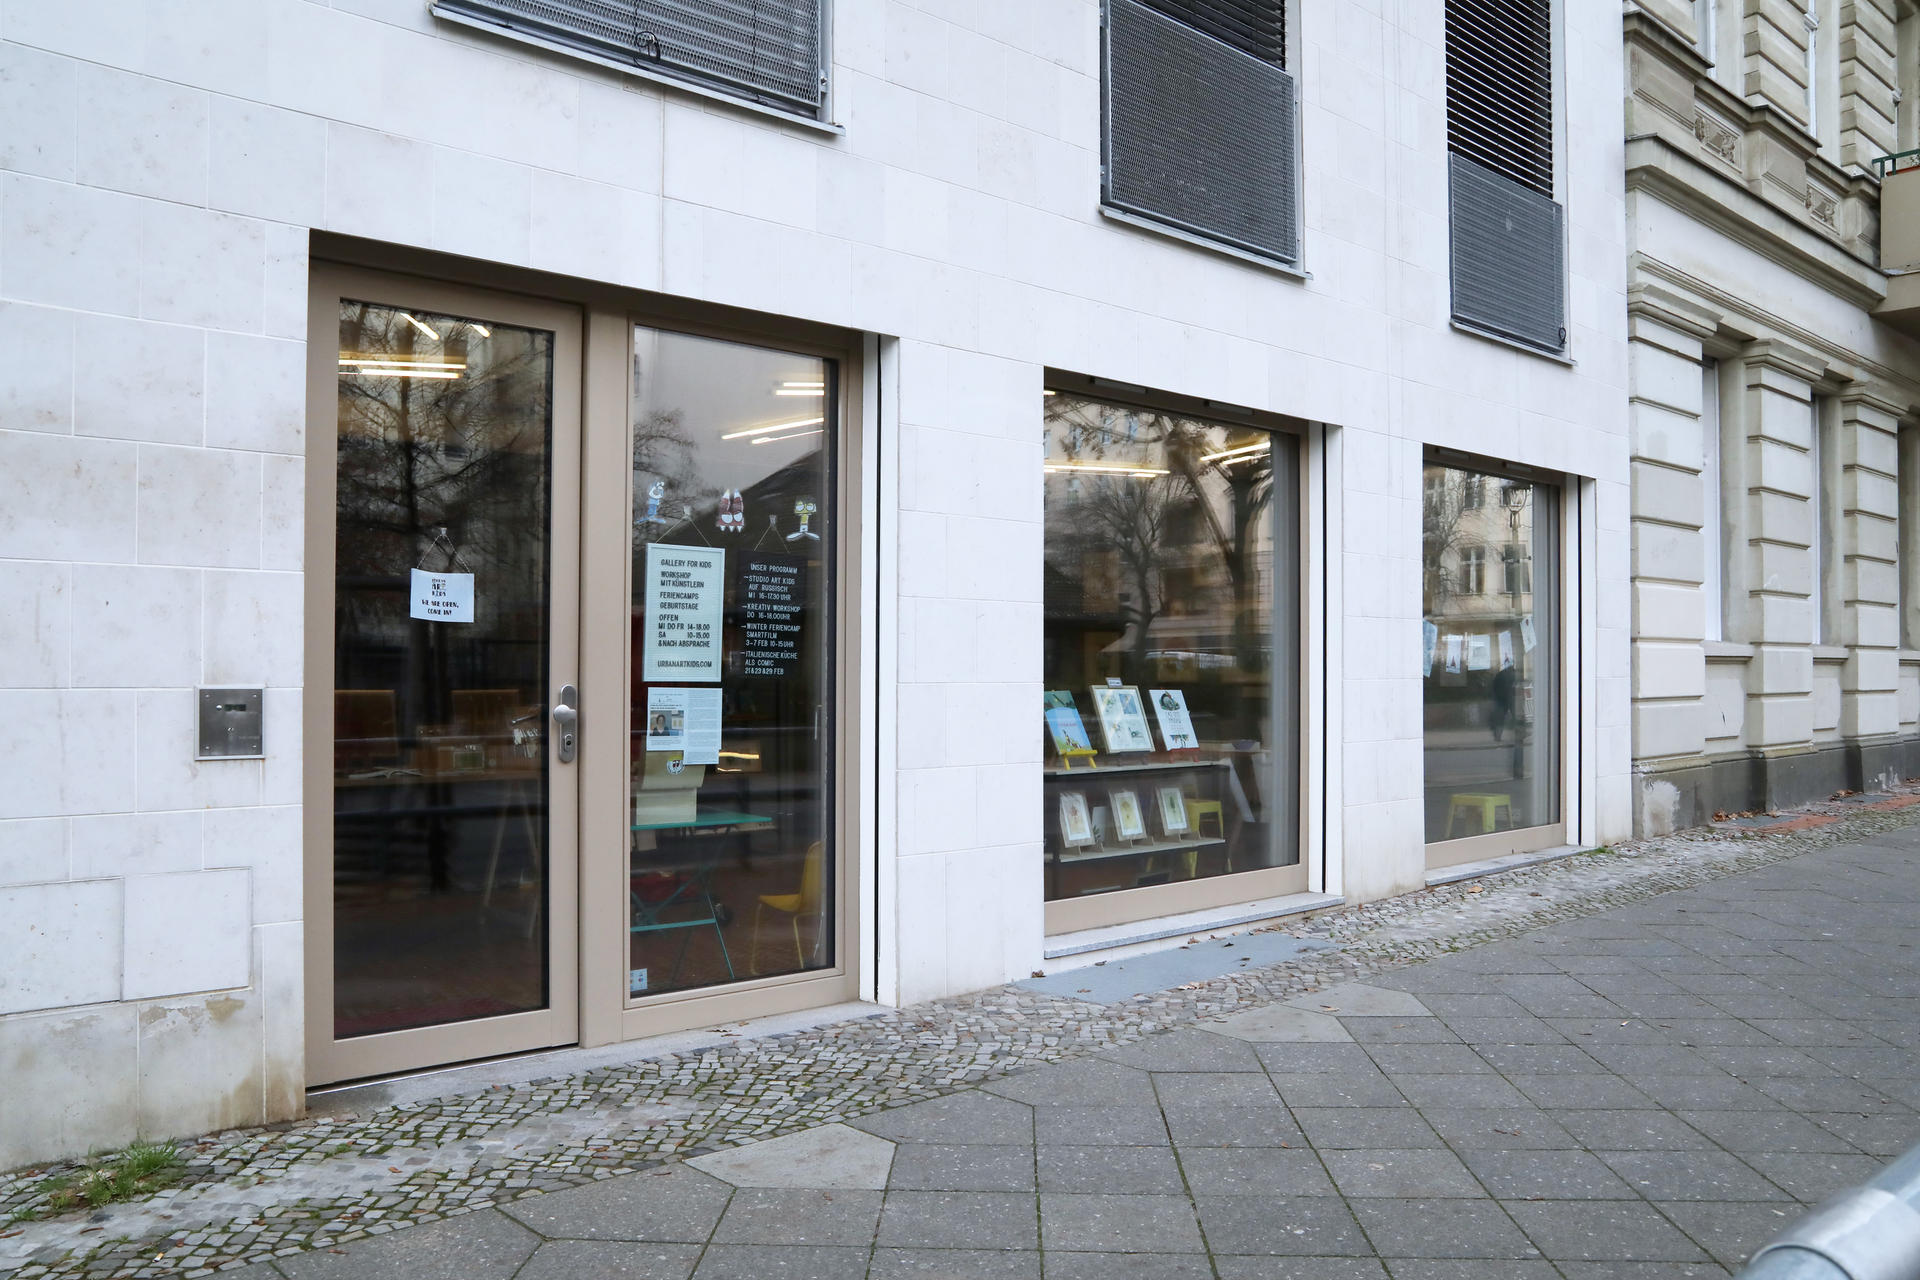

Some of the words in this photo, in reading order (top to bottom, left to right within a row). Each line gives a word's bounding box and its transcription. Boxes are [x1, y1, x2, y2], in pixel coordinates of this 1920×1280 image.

[660, 559, 686, 567] GALLERY
[750, 563, 767, 571] UNSER
[769, 565, 798, 574] PROGRAMM
[661, 571, 692, 579] WORKSHOP
[672, 578, 705, 588] KÜNSTLERN
[748, 575, 770, 583] STUDIO
[782, 577, 795, 585] KIDS
[761, 584, 788, 592] RUSSISCH
[660, 591, 699, 600] FERIENCAMPS
[660, 601, 699, 610] GEBURTSTAGE
[747, 603, 771, 611] KREATIV
[772, 604, 801, 613] WORKSHOP
[658, 622, 666, 630] MI
[667, 622, 676, 630] DO
[746, 622, 768, 630] WINTER
[769, 623, 801, 632] FERIENCAMP
[746, 630, 778, 639] SMARTFILM
[678, 640, 710, 648] ABSPRACHE
[745, 650, 780, 659] ITALIENISCHE
[780, 650, 798, 660] KÜCHE
[657, 660, 712, 668] URBANARTKIDS.COM
